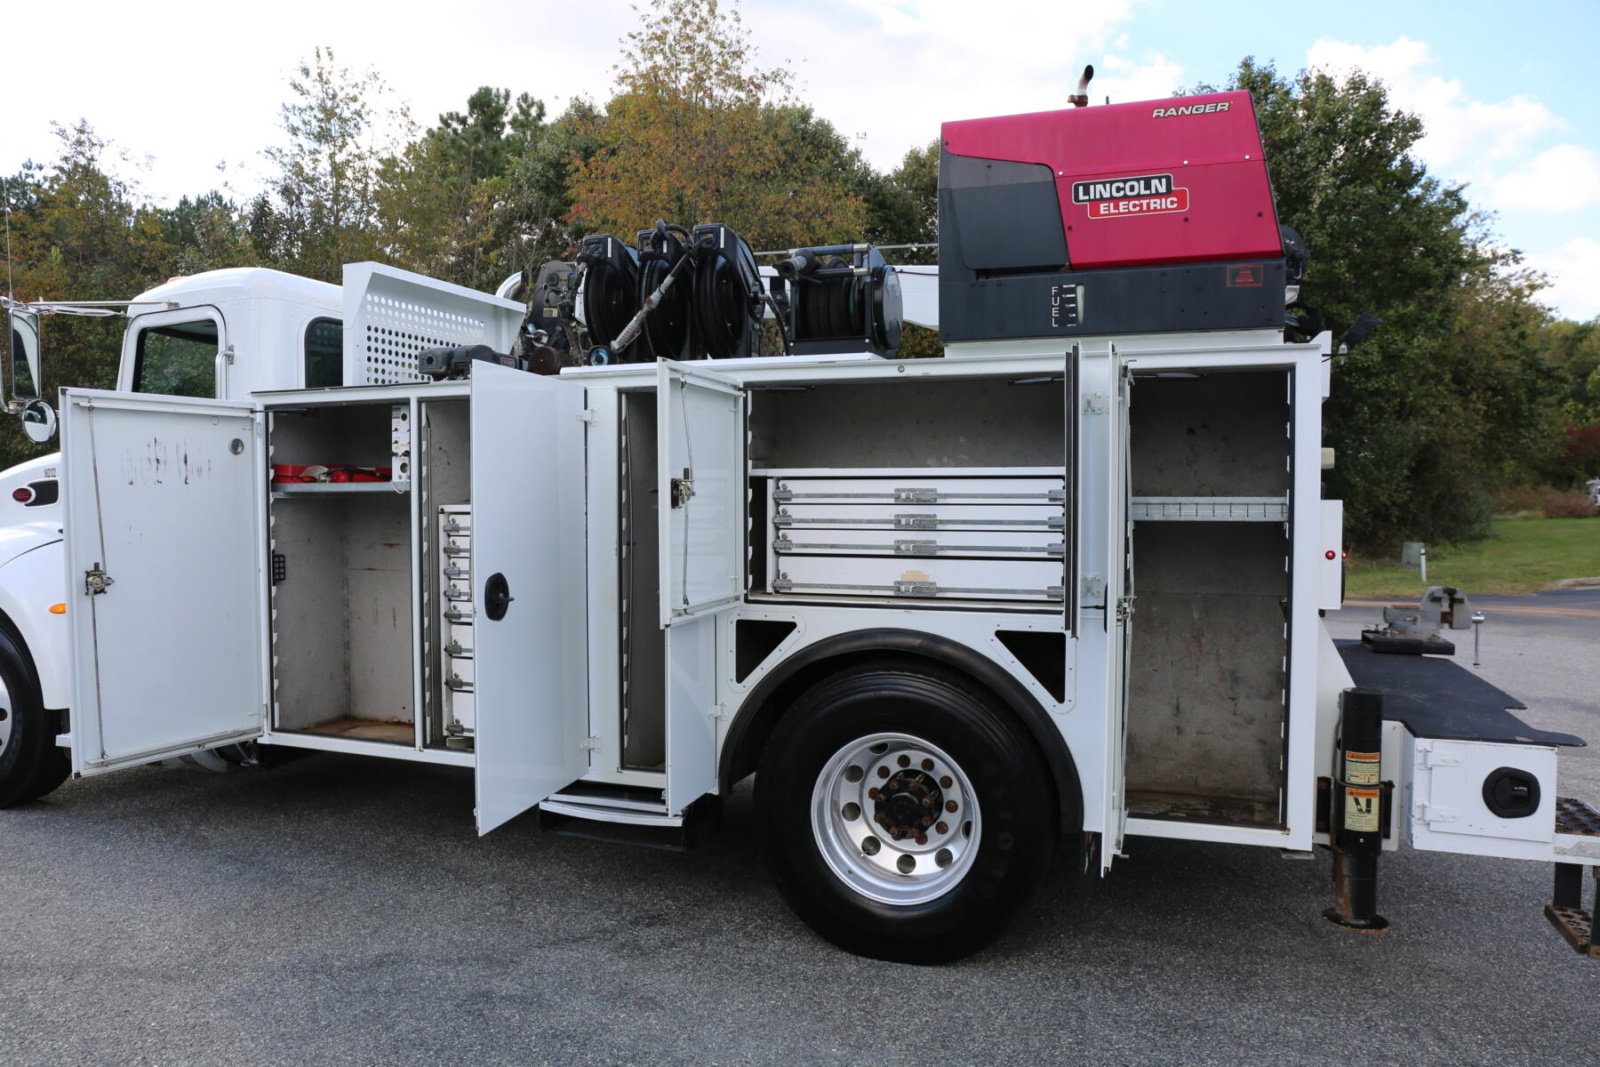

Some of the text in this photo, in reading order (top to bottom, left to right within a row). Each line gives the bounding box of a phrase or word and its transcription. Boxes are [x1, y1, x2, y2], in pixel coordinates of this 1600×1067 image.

[1152, 101, 1230, 119] RANGER
[1078, 177, 1167, 201] LINCOLN
[1099, 196, 1179, 215] ELECTRIC
[1051, 286, 1060, 328] FUEL
